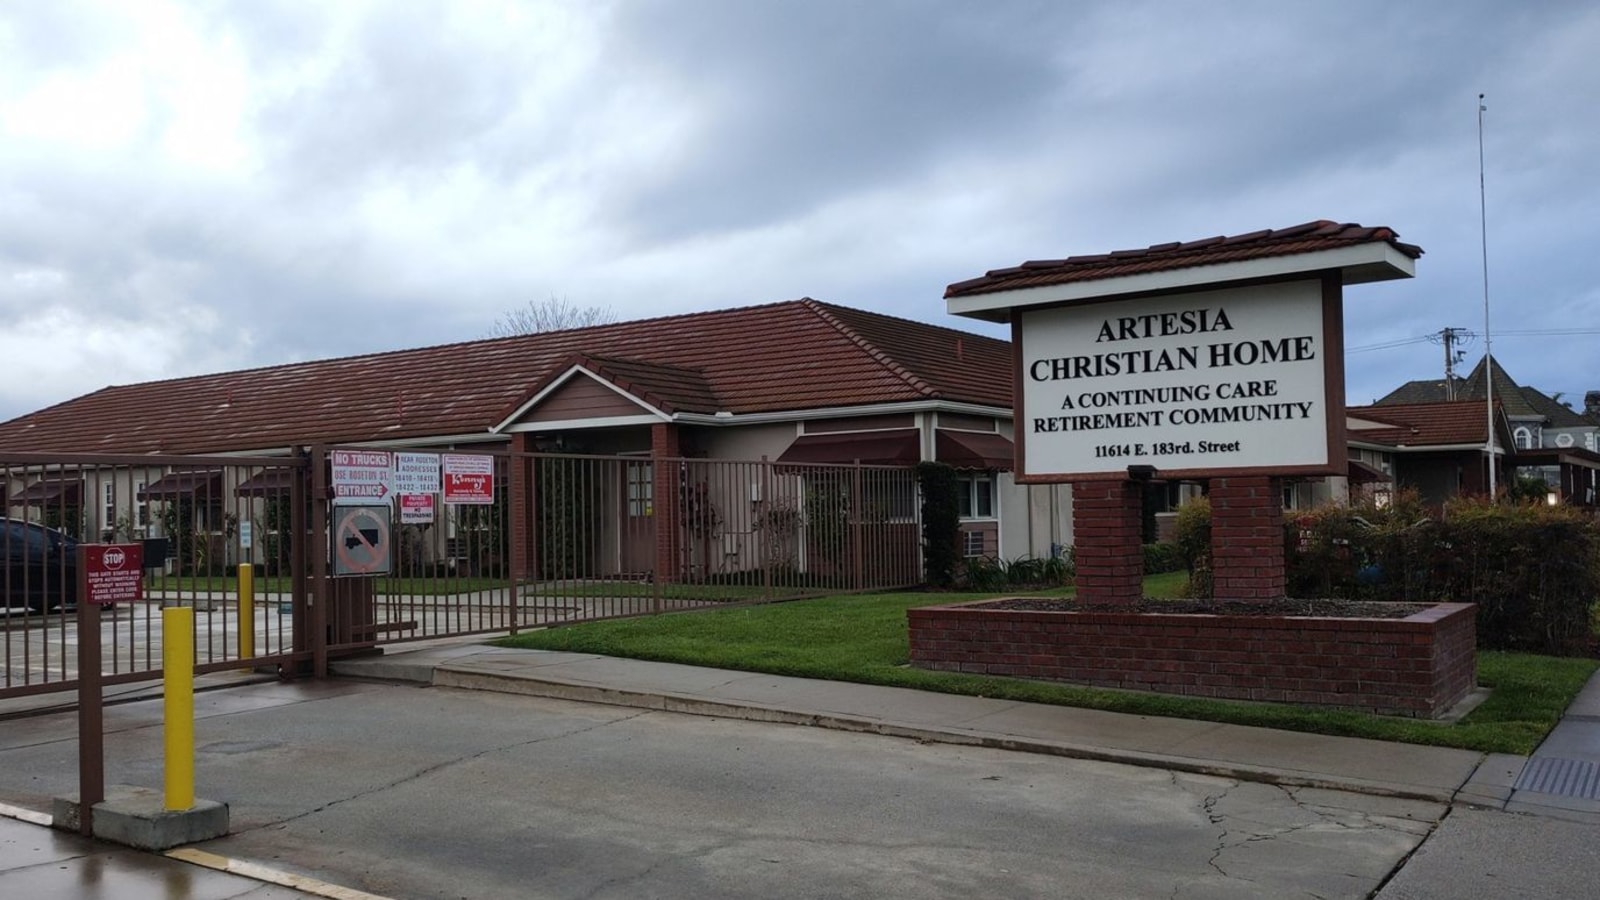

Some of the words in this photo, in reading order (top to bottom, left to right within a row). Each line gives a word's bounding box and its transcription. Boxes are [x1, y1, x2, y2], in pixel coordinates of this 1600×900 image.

[1096, 307, 1233, 343] ARTESIA
[1030, 346, 1198, 382] CHRISTIAN
[1208, 336, 1315, 368] HOME
[1061, 395, 1074, 410] A
[1078, 384, 1210, 408] CONTINUING
[1215, 379, 1277, 399] CARE
[1033, 410, 1164, 433] RETIREMENT
[1169, 401, 1313, 425] COMMUNITY
[1095, 444, 1130, 457] 11614
[1134, 443, 1148, 456] E.
[1152, 442, 1194, 456] 183rd.
[1198, 440, 1240, 453] Street
[335, 453, 349, 465] NO
[351, 454, 388, 466] TRUCKS
[335, 470, 346, 480] USE
[337, 485, 384, 496] ENTRANCE
[104, 553, 123, 565] STOP
